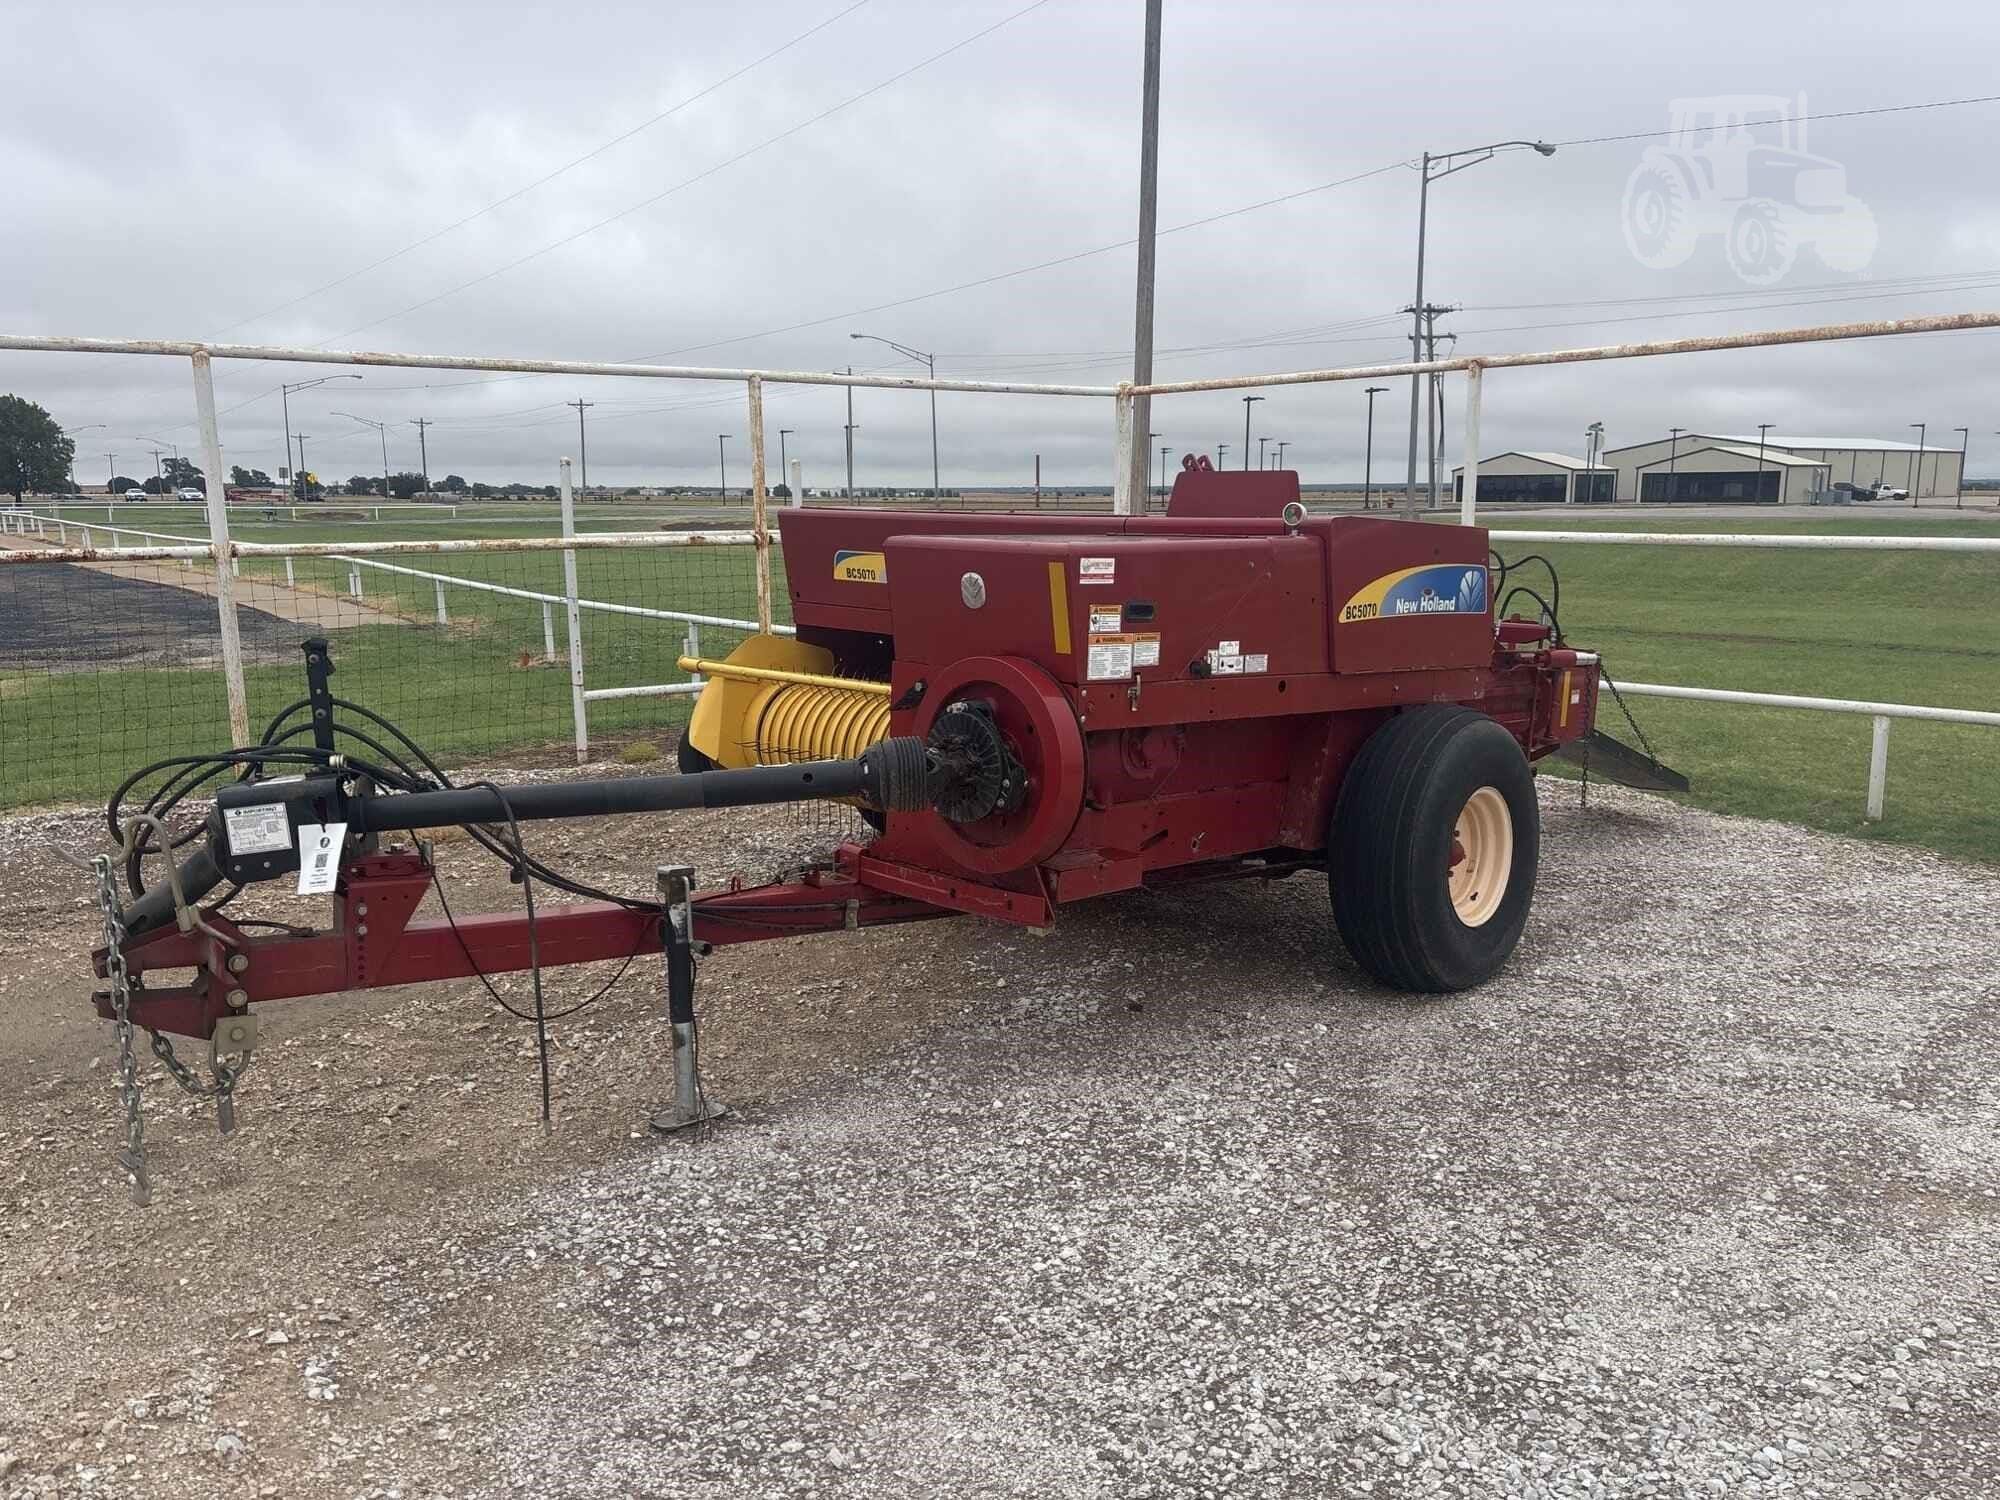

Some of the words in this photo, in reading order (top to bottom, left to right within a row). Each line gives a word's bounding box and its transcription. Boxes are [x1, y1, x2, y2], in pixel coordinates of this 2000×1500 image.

[846, 567, 876, 581] BC5070
[1345, 603, 1377, 620] BC5070
[1396, 598, 1418, 614] New
[1420, 596, 1456, 612] Holland
